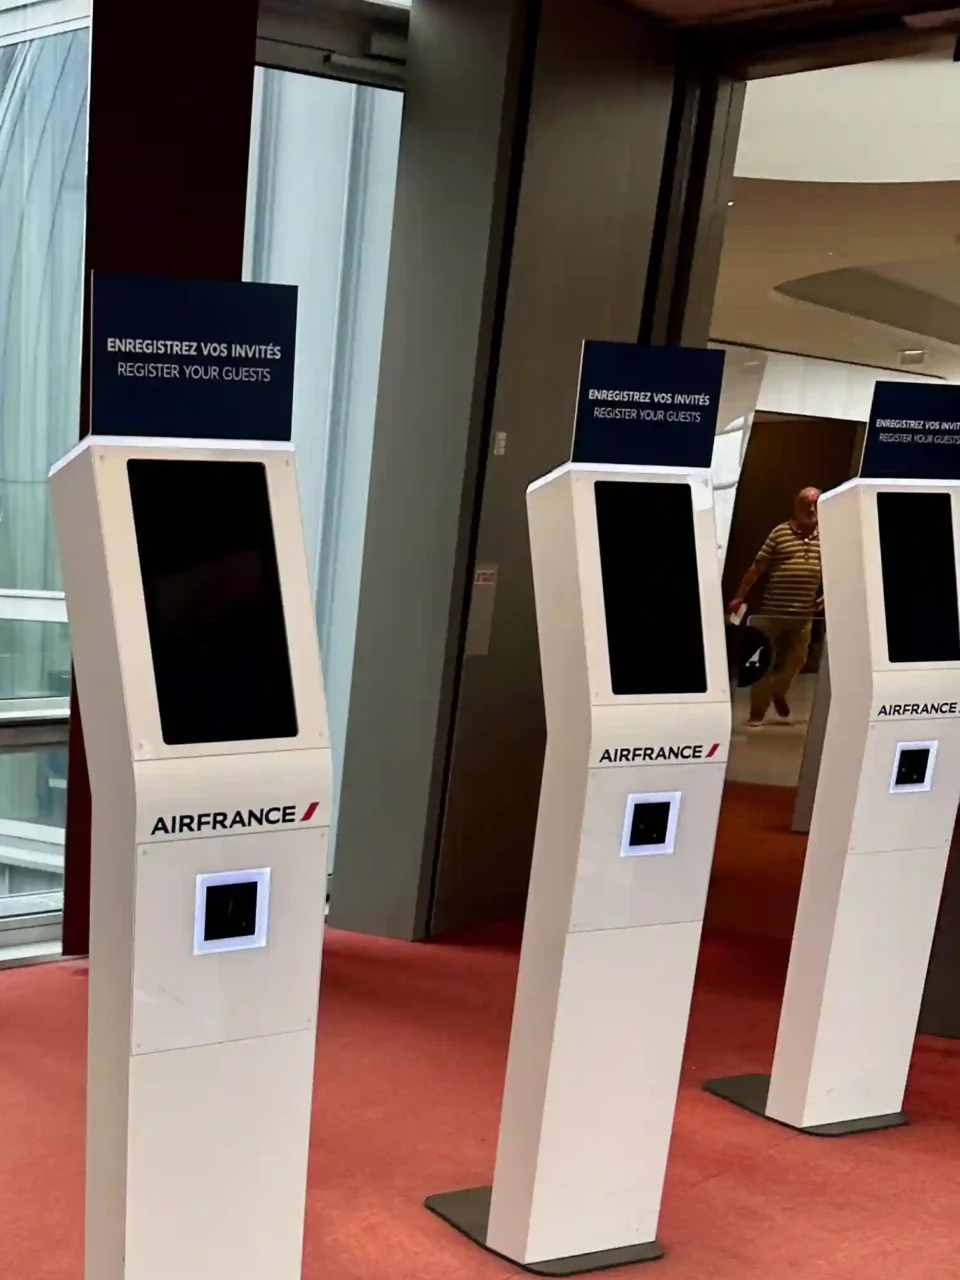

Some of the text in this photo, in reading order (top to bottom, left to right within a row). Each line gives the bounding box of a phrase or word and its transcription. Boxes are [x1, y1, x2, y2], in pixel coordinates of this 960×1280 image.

[107, 338, 281, 360] ENREGISTREZ VOS INVITÉS
[118, 362, 271, 382] REGISTER YOUR GUESTS
[588, 389, 710, 406] ENREGISTREZ VOS INVITÉS
[593, 407, 701, 423] REGISTER YOUR GUESTS
[876, 418, 923, 429] ENREGISTREZ
[925, 421, 940, 430] VOS
[879, 432, 912, 443] REGISTER
[914, 434, 933, 443] YOUR
[877, 702, 958, 717] AIRFRANCE
[599, 745, 703, 763] AIRFRANCE
[150, 805, 296, 836] AIRFRANCE
